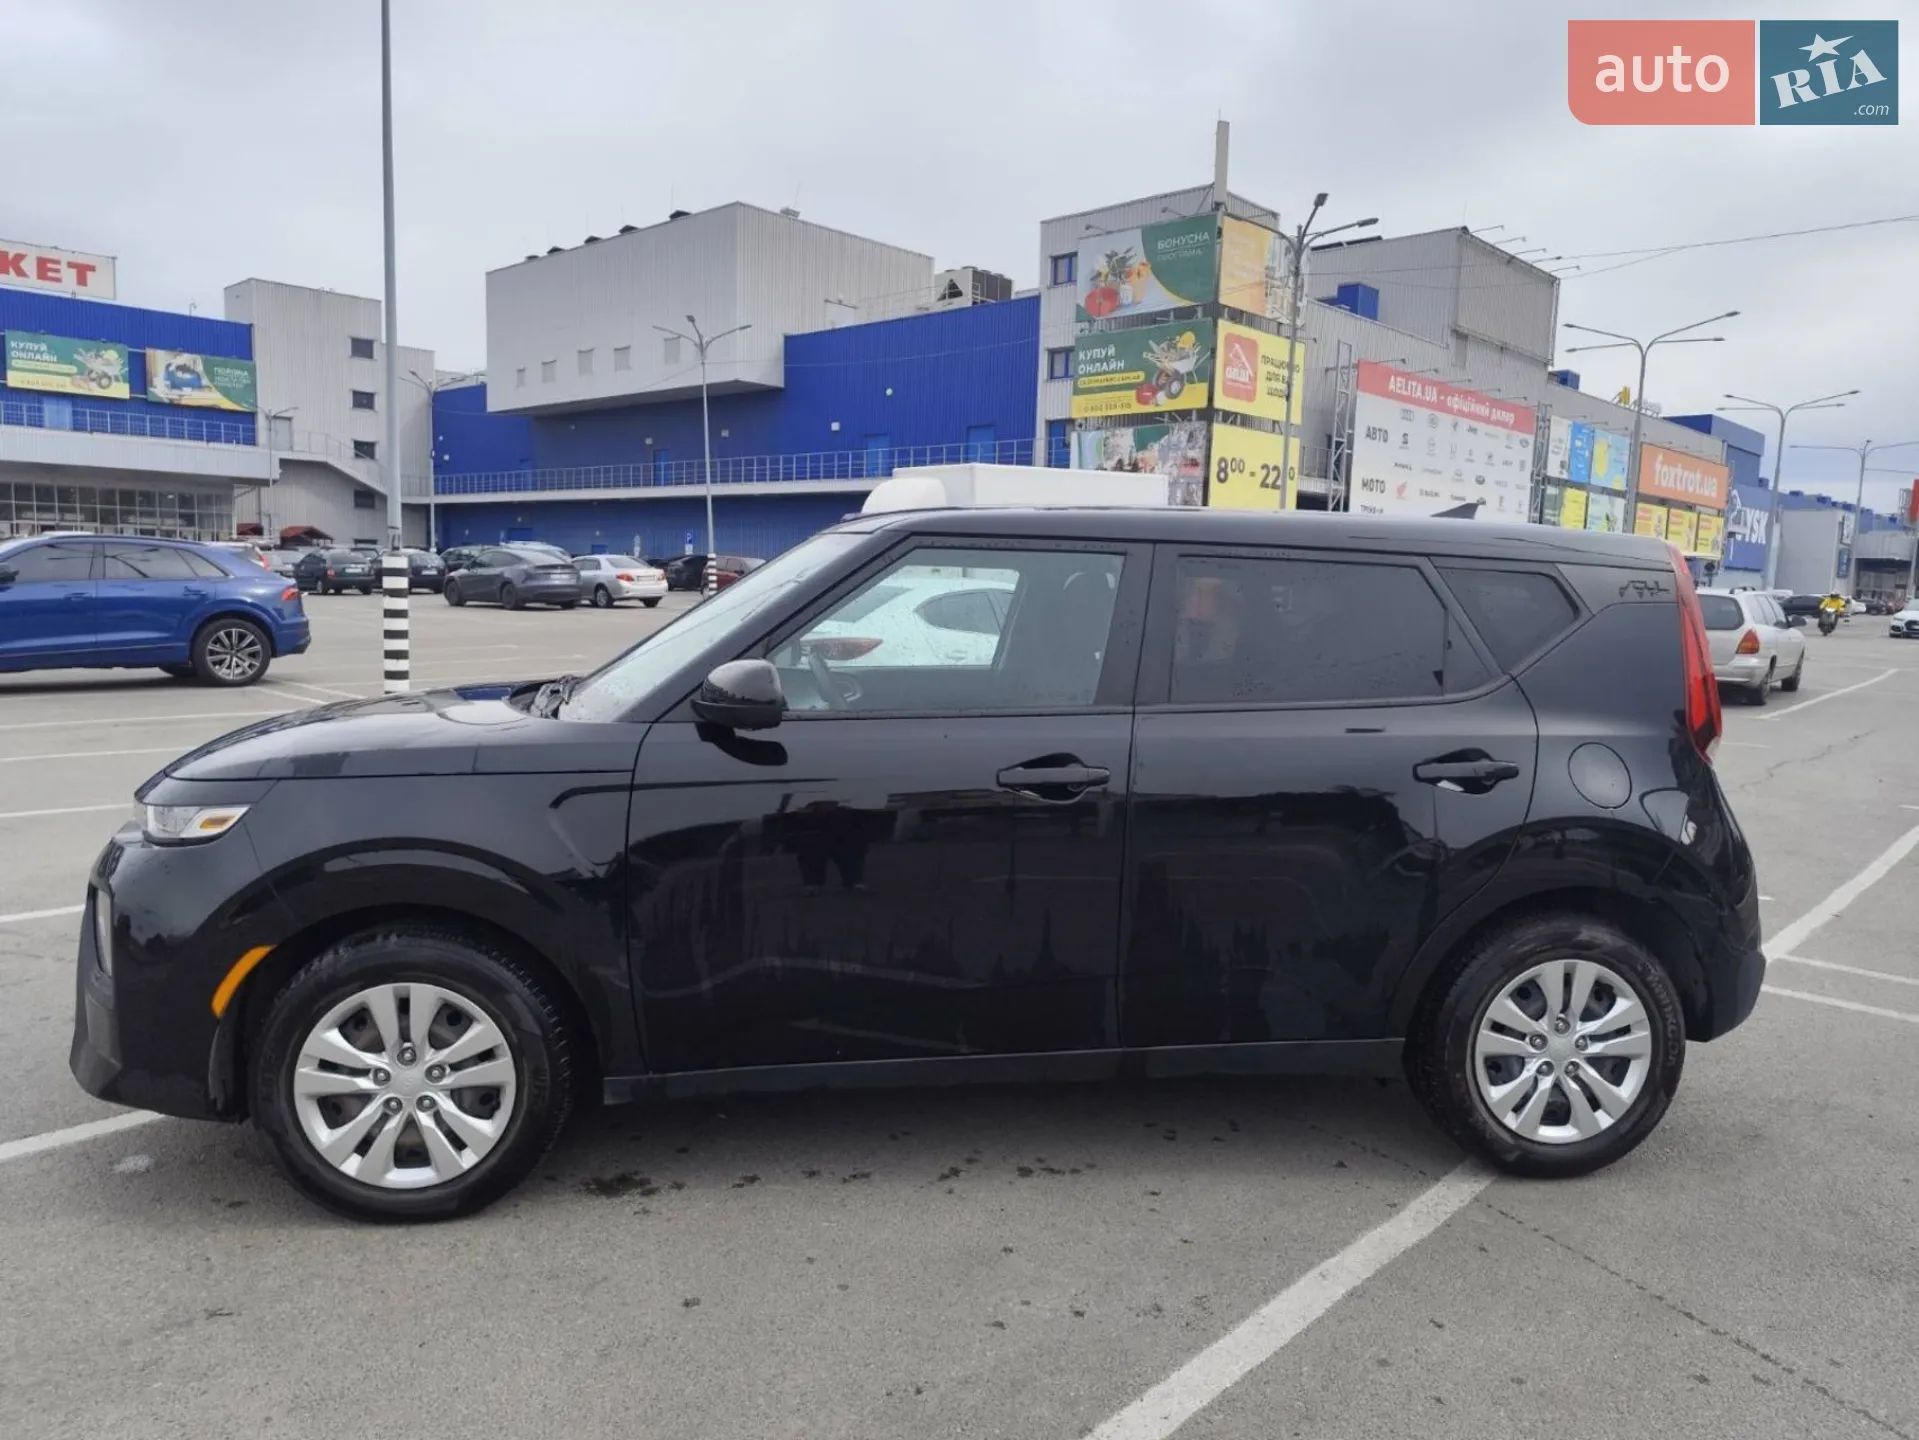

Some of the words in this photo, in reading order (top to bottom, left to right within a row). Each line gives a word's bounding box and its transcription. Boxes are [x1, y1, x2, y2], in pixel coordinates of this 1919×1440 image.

[1157, 231, 1210, 250] БОНУСНА
[1079, 345, 1116, 361] КУПУЙ
[1078, 359, 1125, 374] ОНЛАЙН
[1388, 375, 1438, 403] AELITA.UA
[1365, 426, 1389, 443] АВТО
[1361, 477, 1386, 494] МОТО
[1654, 457, 1718, 498] foxtrot.ua
